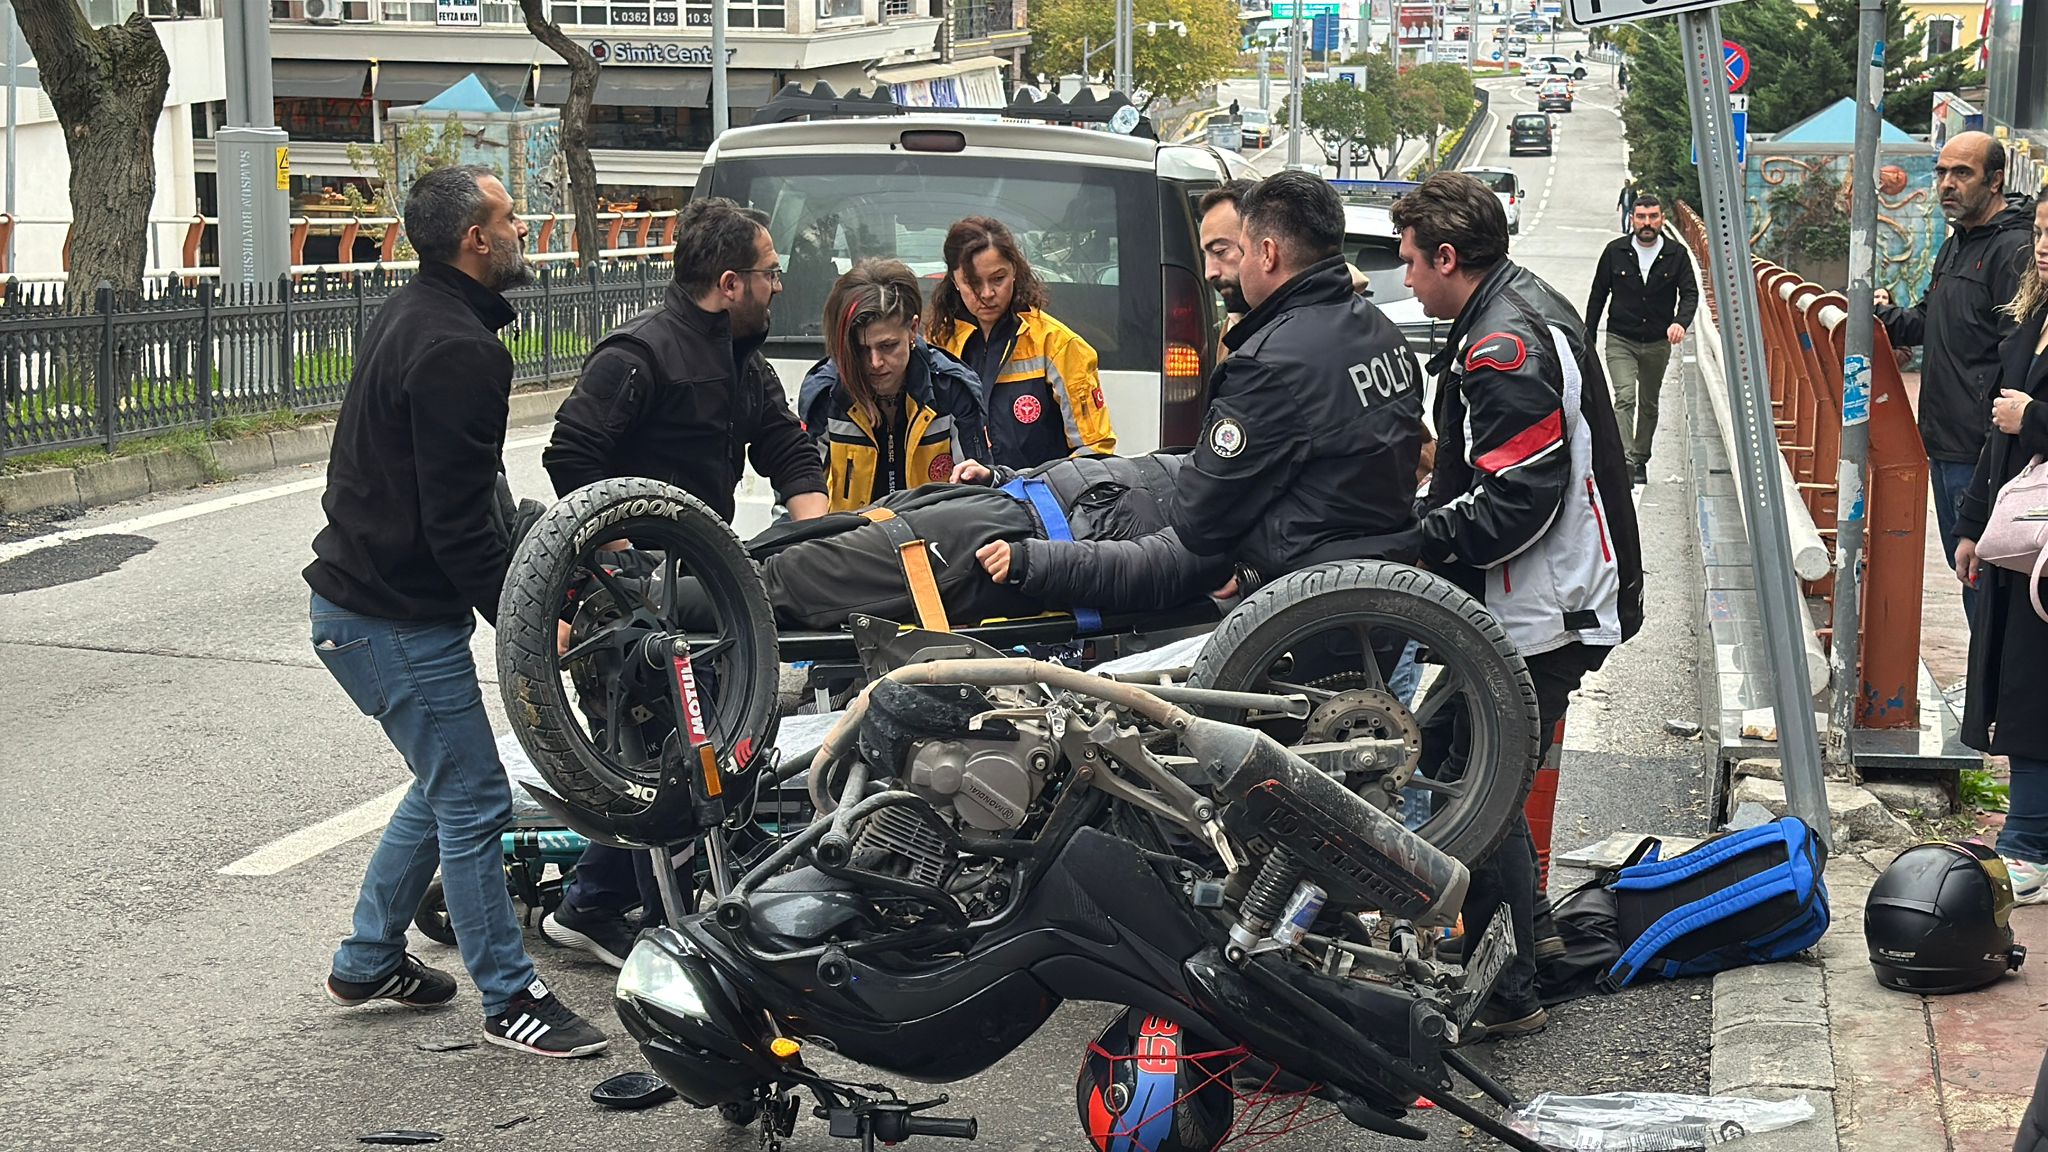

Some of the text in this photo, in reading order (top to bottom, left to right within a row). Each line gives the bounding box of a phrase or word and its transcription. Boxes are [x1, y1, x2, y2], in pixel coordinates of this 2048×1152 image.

[439, 12, 478, 21] FEYZA KAYA
[621, 12, 648, 23] 0362
[655, 12, 676, 23] 439
[688, 13, 700, 23] 10
[240, 150, 251, 207] SAMSUN
[680, 660, 706, 735] MOTUL
[969, 785, 1003, 812] MONDIAL
